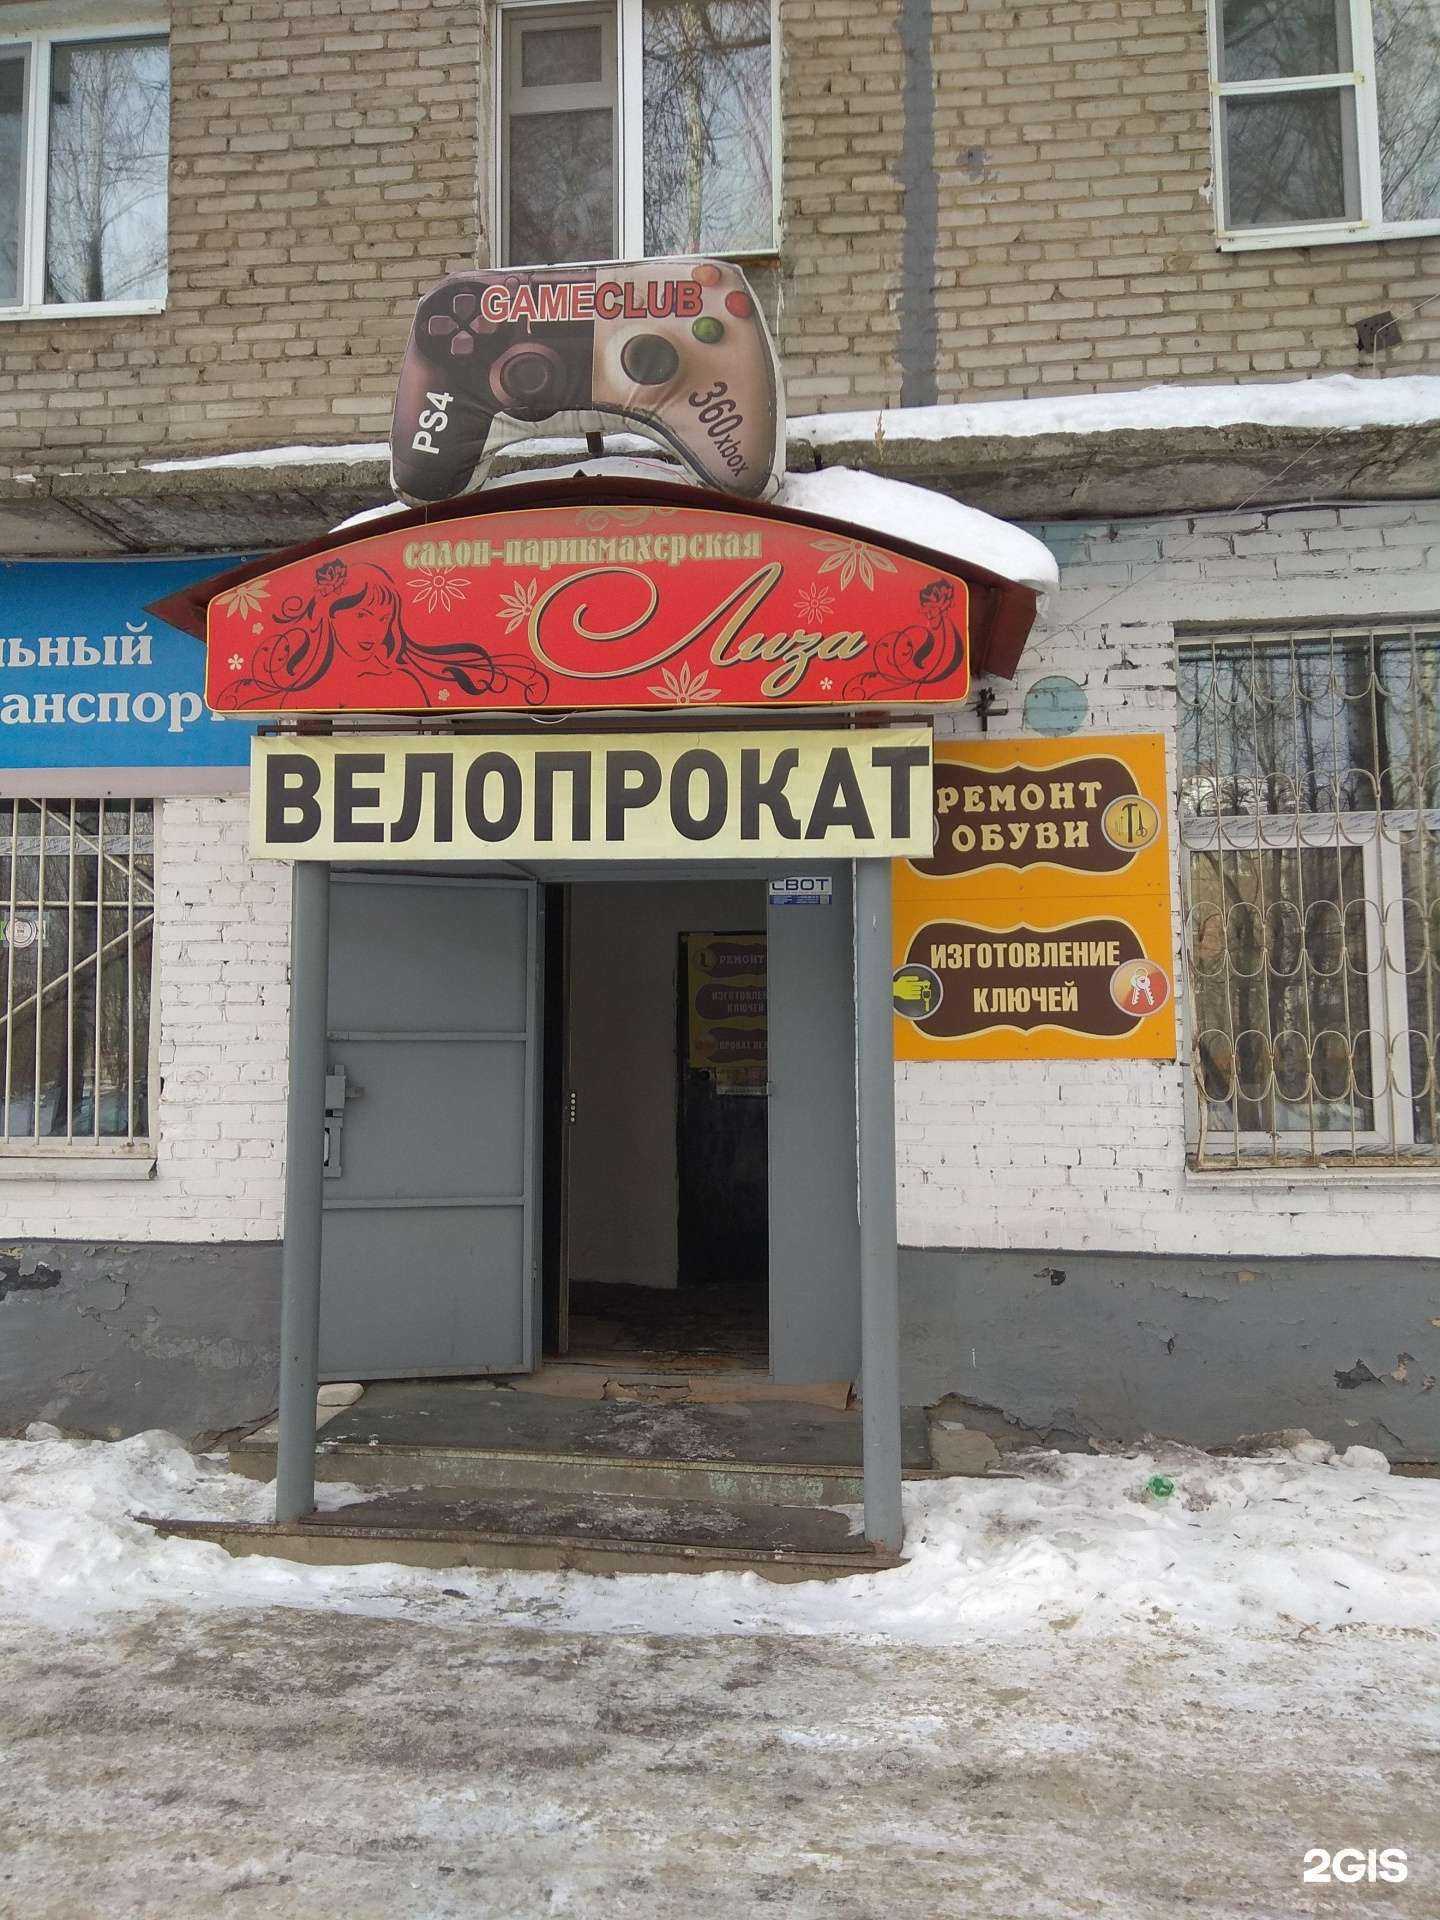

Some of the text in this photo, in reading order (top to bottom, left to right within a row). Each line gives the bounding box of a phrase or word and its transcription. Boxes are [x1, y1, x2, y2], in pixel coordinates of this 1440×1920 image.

[411, 390, 454, 455] PS4
[402, 531, 764, 570] салон-парикмахерская
[0, 621, 153, 668] ьный
[527, 561, 869, 698] Лиза
[0, 691, 226, 733] анспор
[265, 745, 930, 844] ВЕЛОПРОКАТ
[936, 781, 1103, 814] РЕМОНТ
[951, 820, 1090, 852] ОБУВИ
[930, 941, 1121, 969] ИЗГОТОВЛЕНИЕ
[973, 981, 1079, 1013] КЛЮЧЕЙ
